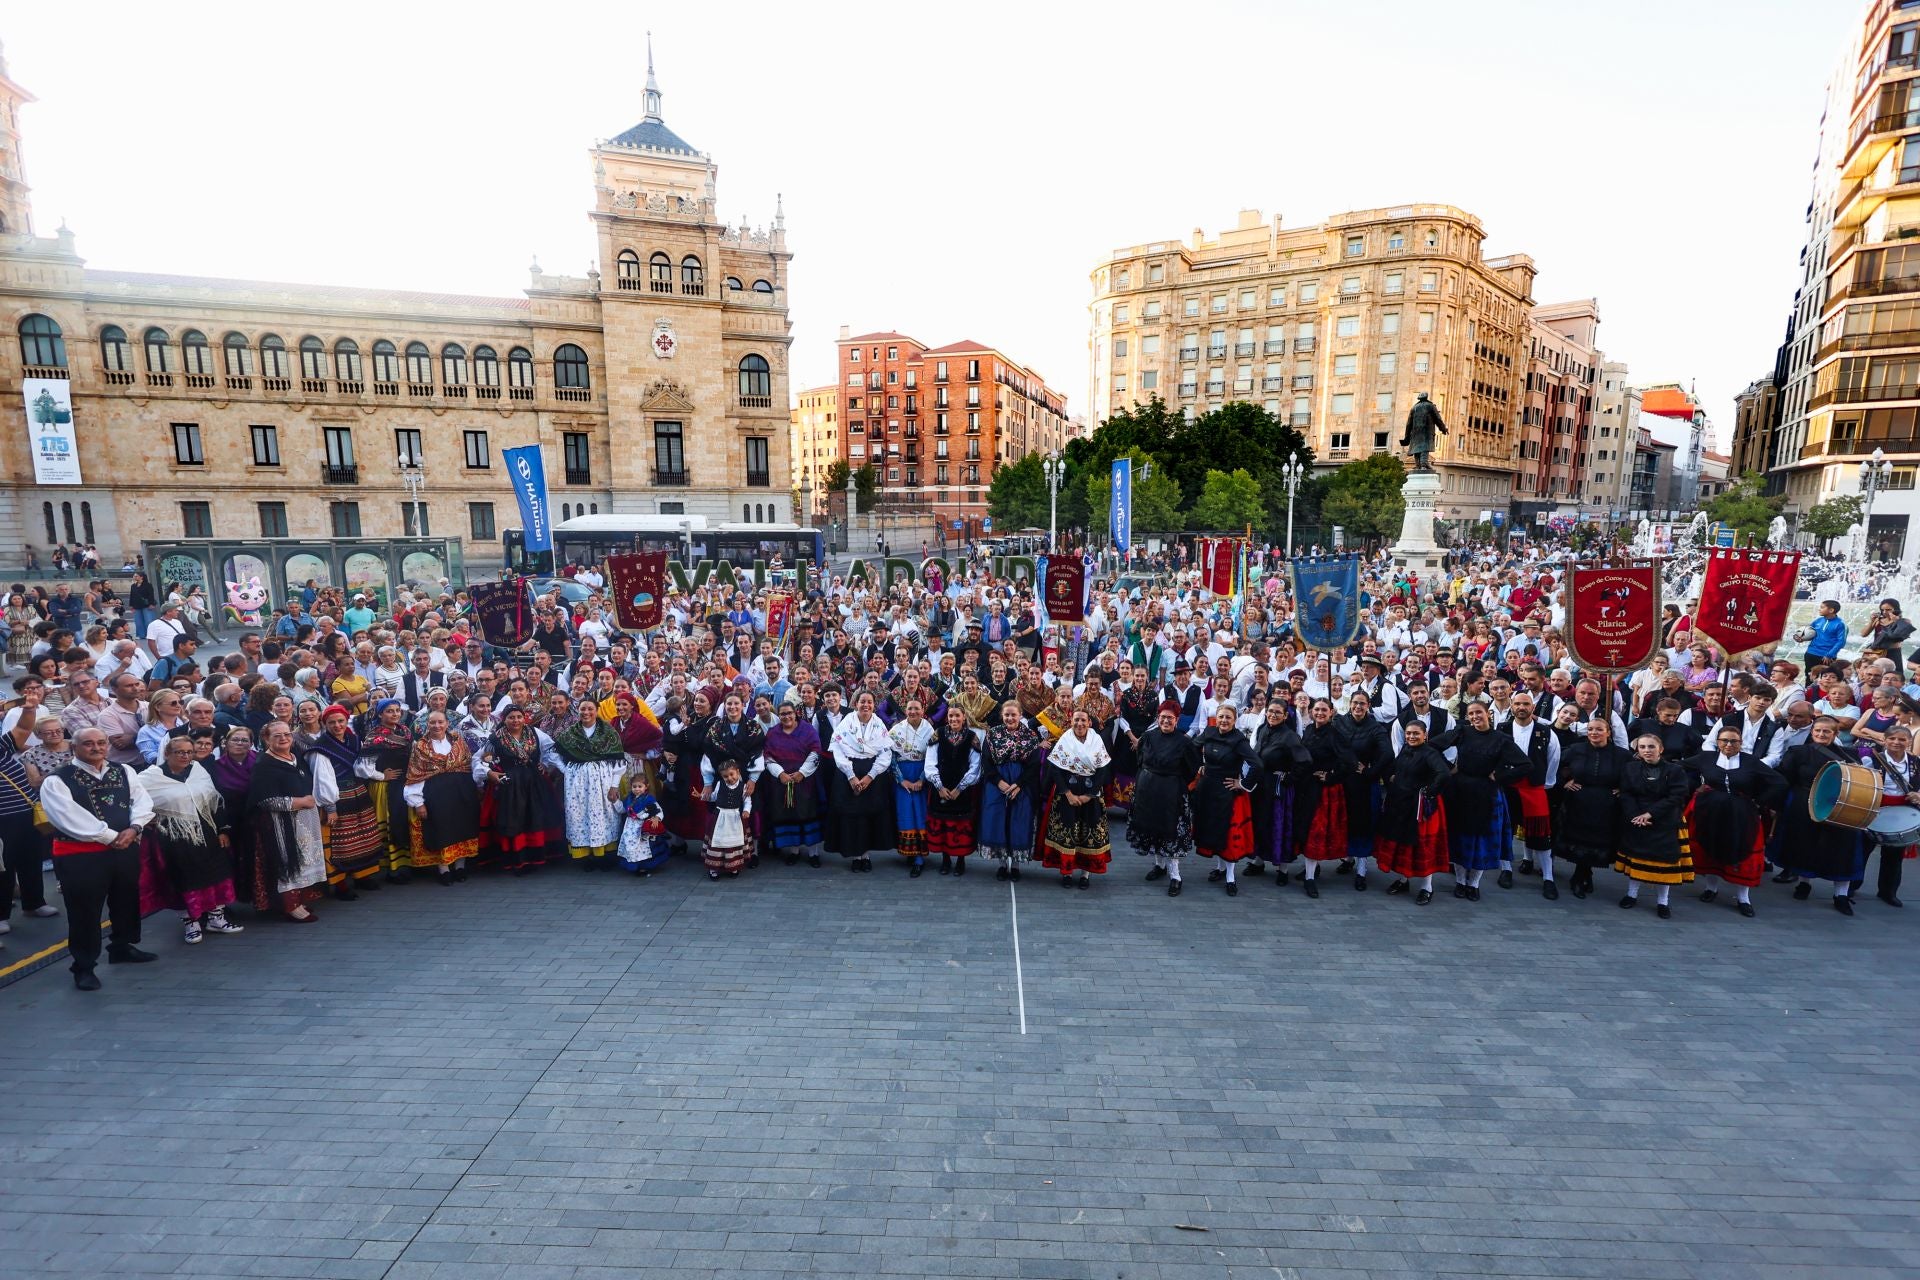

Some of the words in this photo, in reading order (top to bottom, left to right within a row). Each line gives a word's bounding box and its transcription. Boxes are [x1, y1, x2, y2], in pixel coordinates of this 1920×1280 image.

[525, 482, 542, 542] HYUNDAI
[984, 518, 991, 526] P
[165, 568, 195, 577] MARCH
[1578, 580, 1596, 593] Grupo
[1627, 577, 1649, 591] Danzas
[1719, 579, 1741, 588] GRUPO
[1751, 581, 1776, 596] DANZAS
[1582, 623, 1614, 637] Asociación
[1615, 622, 1644, 637] Folklórica
[1597, 620, 1627, 628] Pilarica
[1719, 621, 1758, 634] VALLADOLID
